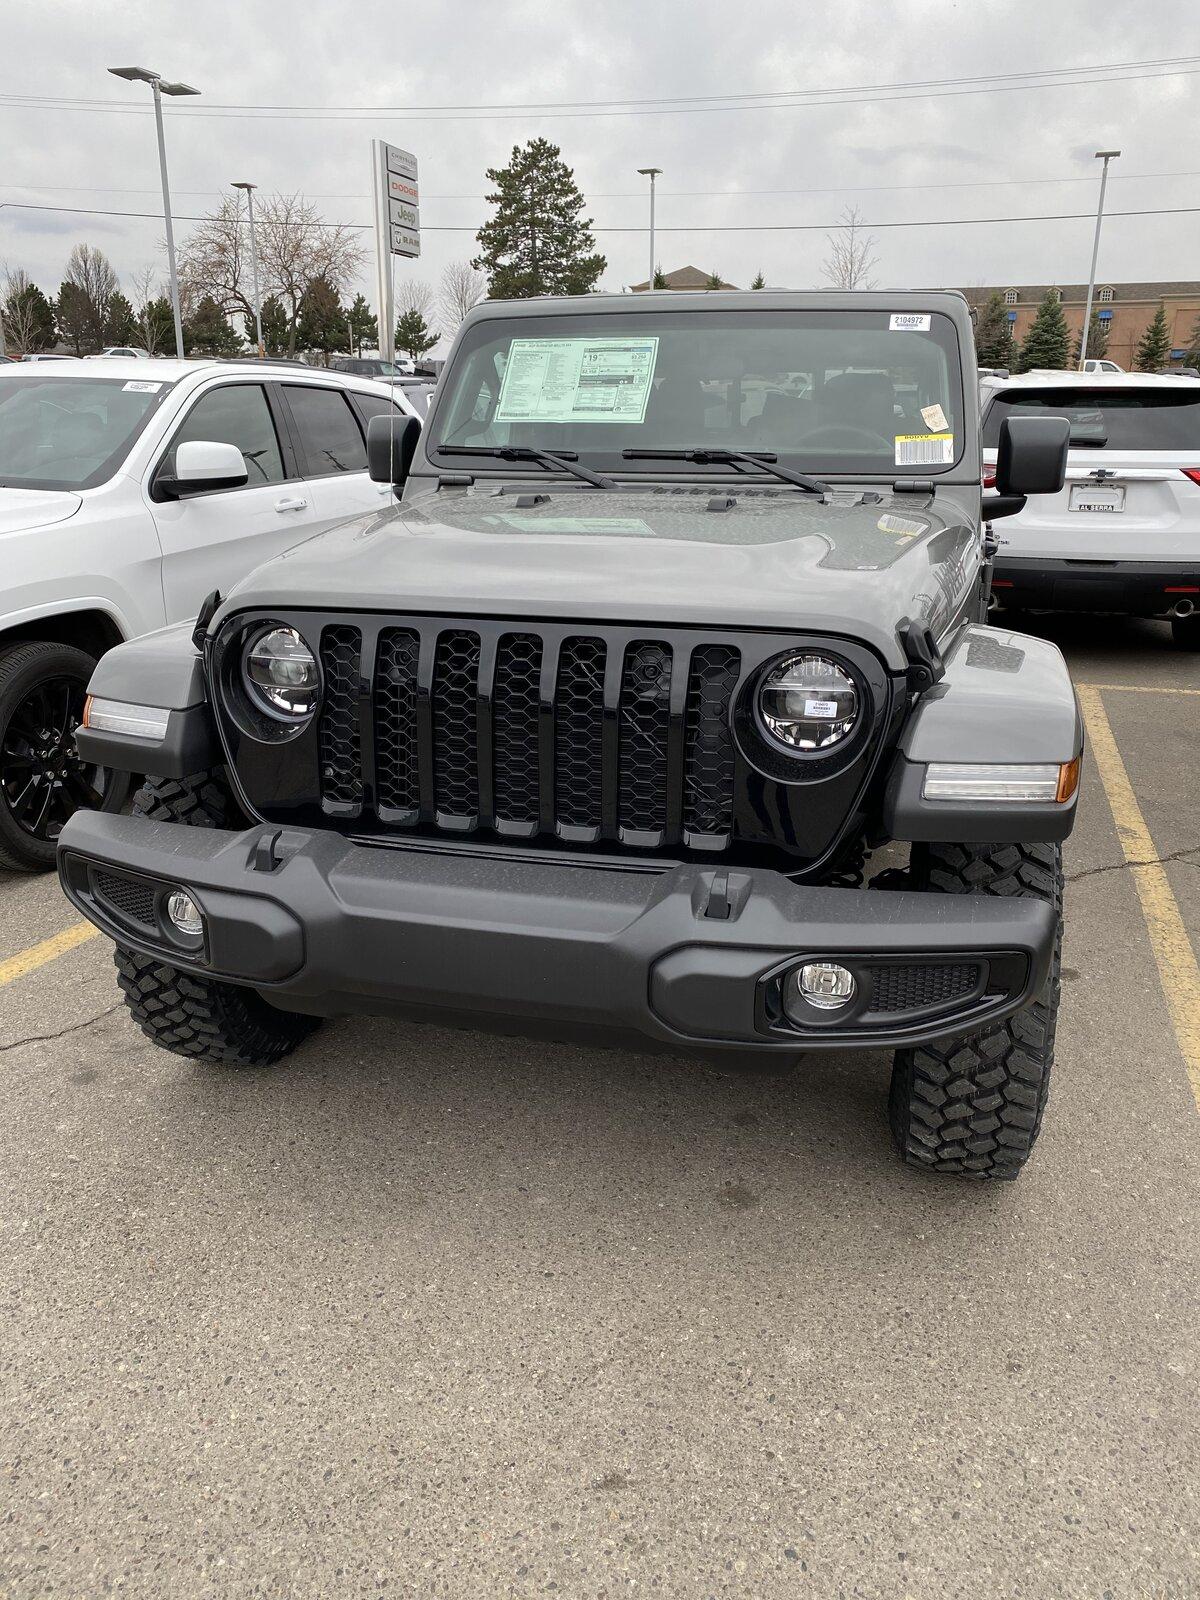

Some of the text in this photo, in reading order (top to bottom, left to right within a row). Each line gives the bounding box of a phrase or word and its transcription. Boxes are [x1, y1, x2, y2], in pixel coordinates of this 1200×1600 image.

[391, 182, 418, 197] DODGE
[397, 205, 416, 226] Jeep
[403, 236, 419, 248] RAM
[894, 316, 924, 324] 2104972
[588, 354, 598, 362] 19
